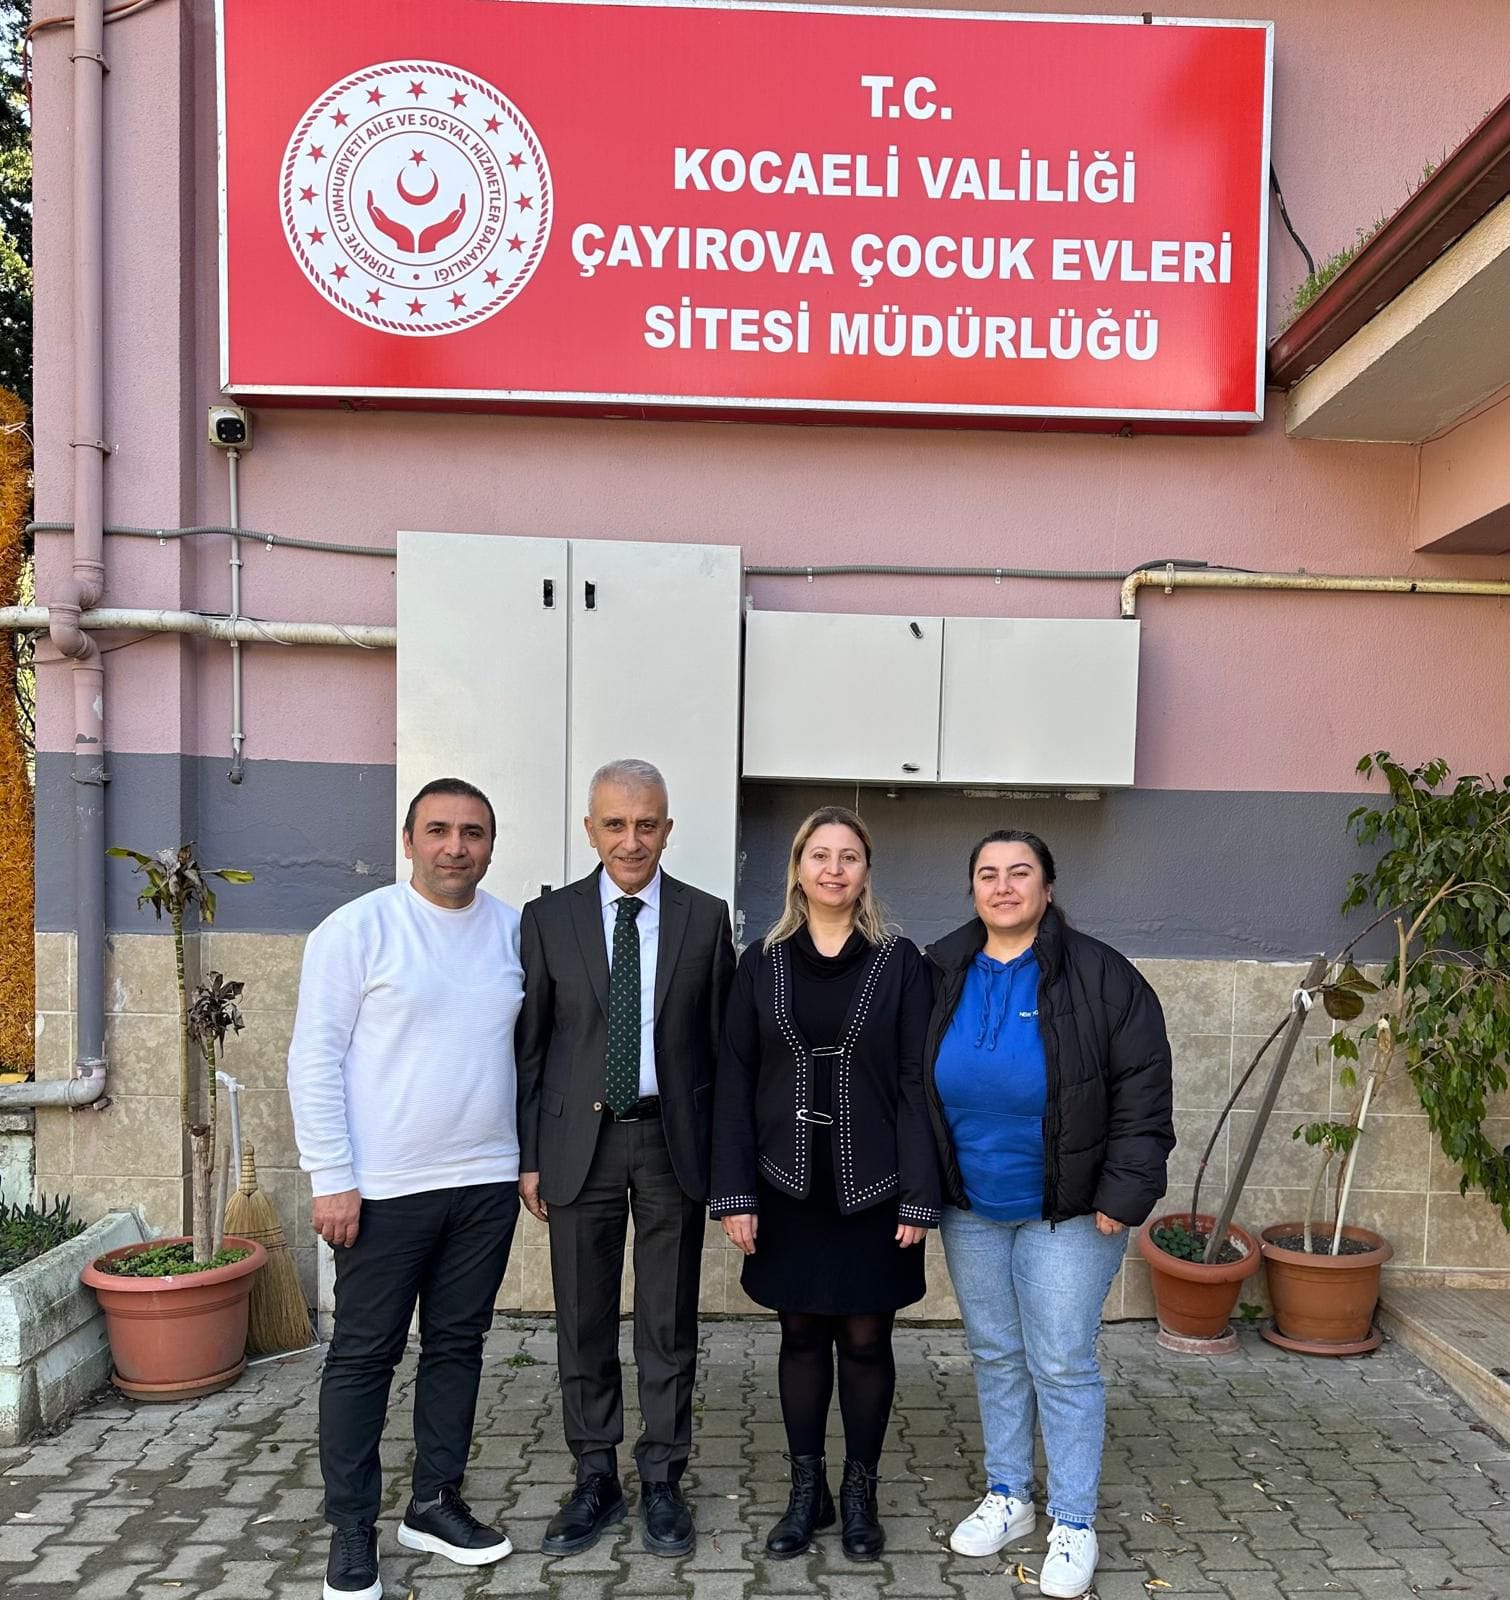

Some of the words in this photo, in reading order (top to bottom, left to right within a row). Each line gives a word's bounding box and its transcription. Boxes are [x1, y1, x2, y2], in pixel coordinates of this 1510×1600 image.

[396, 114, 416, 126] VE
[861, 75, 952, 120] T.C.
[366, 117, 396, 140] AİLE
[419, 114, 470, 146] SOSYAL
[332, 133, 367, 232] CUMHURİYETİ
[469, 142, 502, 223] HİZMETLER
[674, 145, 899, 199] KOCAELİ
[917, 148, 1136, 204] VALİLİĞİ
[344, 233, 396, 279] TÜRKİYE
[434, 225, 496, 282] BAKANLIĞI
[571, 223, 835, 278] ÇAYIROVA
[850, 234, 1035, 288] ÇOCUK
[1052, 231, 1232, 285] EVLERİ
[643, 296, 811, 354] SİTESİ
[830, 304, 1159, 362] MÜDÜRLÜĞÜ
